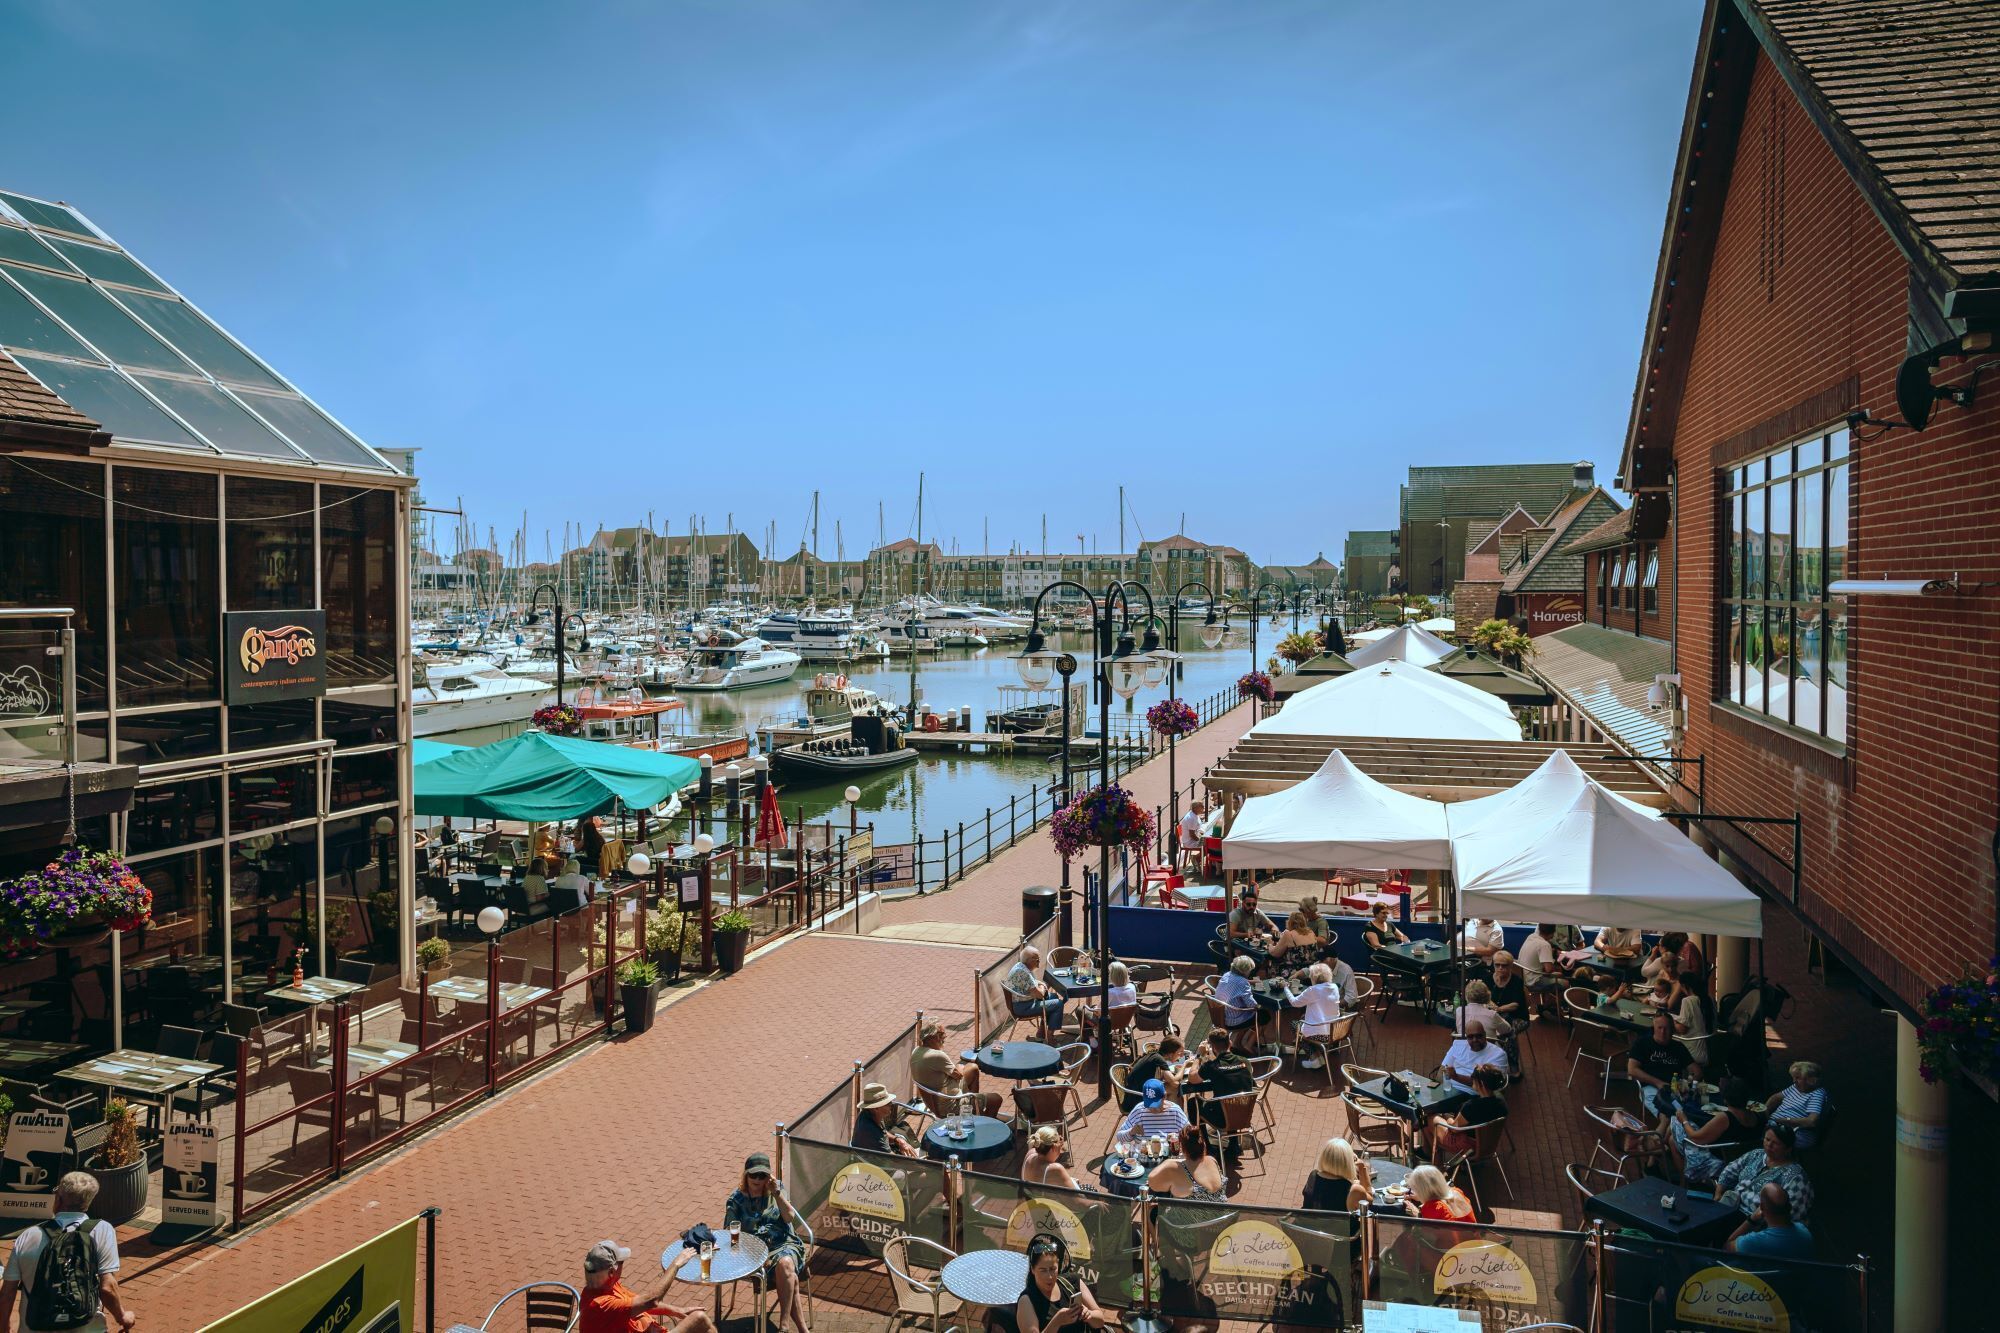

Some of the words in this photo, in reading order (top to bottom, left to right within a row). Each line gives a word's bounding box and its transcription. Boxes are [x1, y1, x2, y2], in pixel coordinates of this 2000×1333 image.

[1533, 611, 1584, 622] Harvest
[15, 1113, 63, 1127] LAVAZZA
[169, 1123, 214, 1138] LAVAZZA
[3, 1200, 29, 1208] SERVED
[29, 1201, 47, 1209] HERE
[856, 1196, 874, 1206] Coffee
[874, 1199, 894, 1209] Lounge
[168, 1206, 192, 1214] SERVED
[193, 1208, 209, 1216] HERE
[1243, 1258, 1266, 1268] Coffee
[1267, 1261, 1290, 1270] Lounge
[1471, 1279, 1493, 1288] Coffee
[1495, 1283, 1522, 1292] Lounge
[1201, 1281, 1315, 1305] BEECHDEAN
[1225, 1296, 1247, 1304] DAIRY
[1249, 1297, 1262, 1305] ICE
[1263, 1299, 1291, 1308] CREAM
[1716, 1307, 1743, 1317] Coffee
[1744, 1311, 1773, 1323] Lounge
